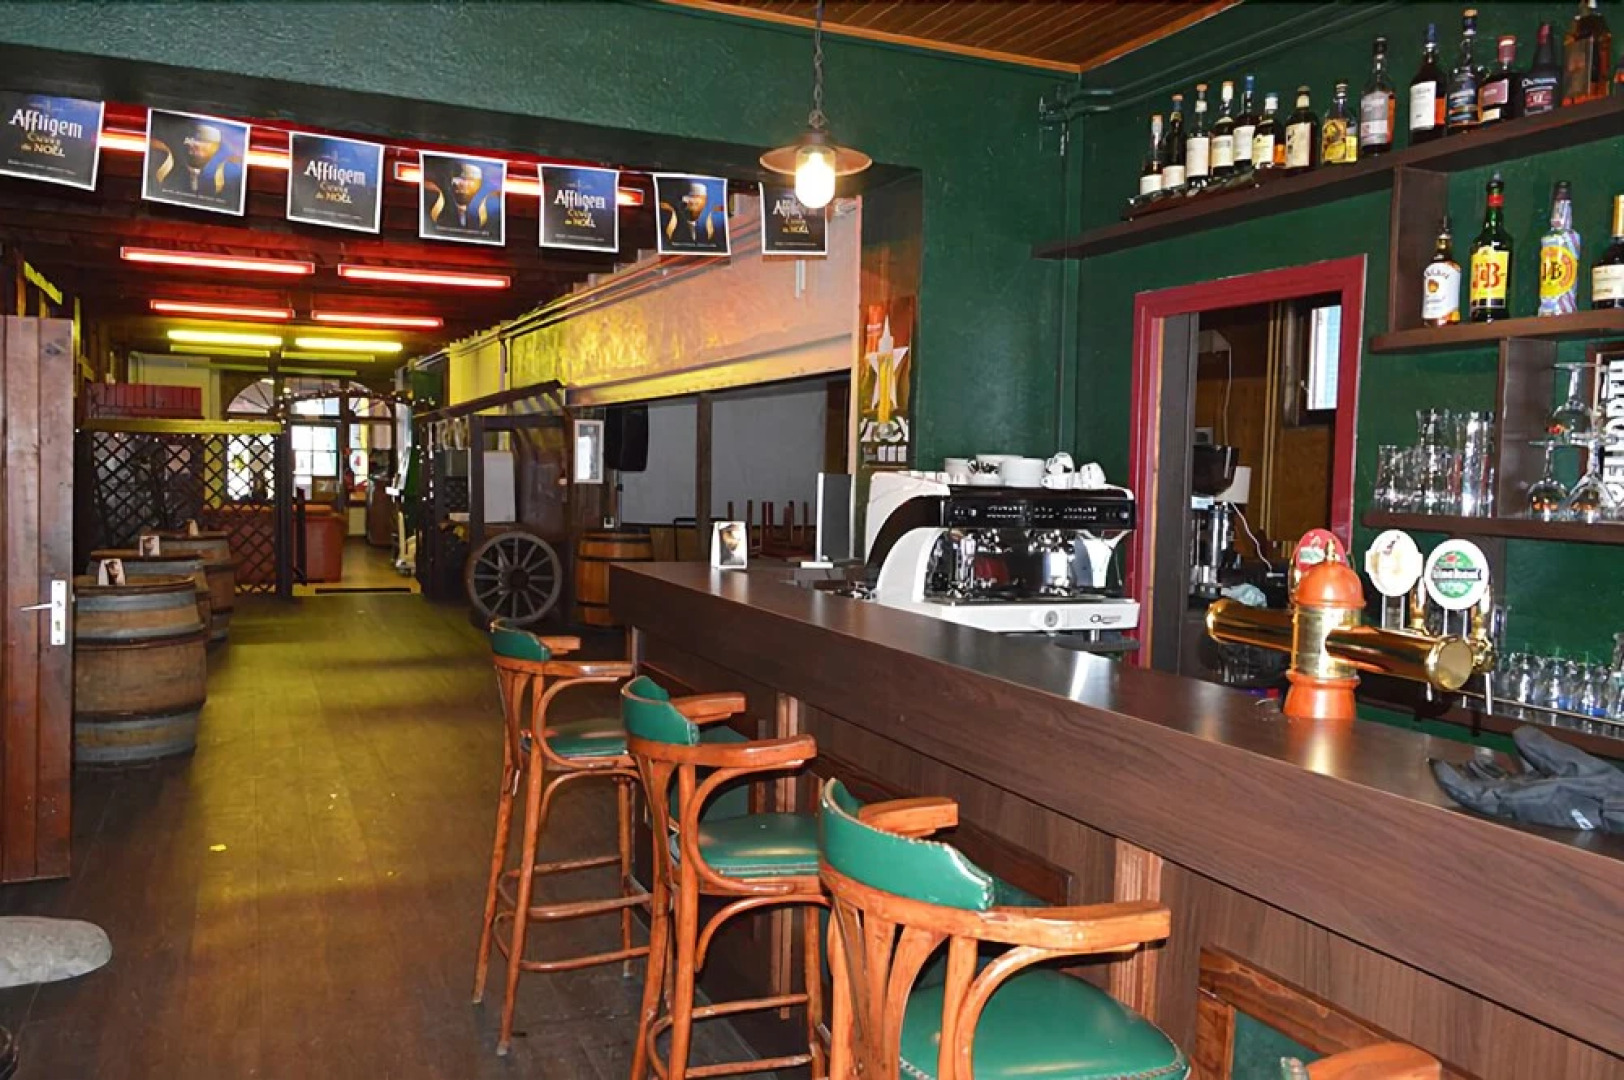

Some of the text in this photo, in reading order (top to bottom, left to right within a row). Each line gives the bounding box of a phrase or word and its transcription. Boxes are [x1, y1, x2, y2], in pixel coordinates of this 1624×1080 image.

[8, 108, 83, 138] Affligem
[303, 159, 367, 188] Affligem
[1471, 262, 1501, 290] J&B
